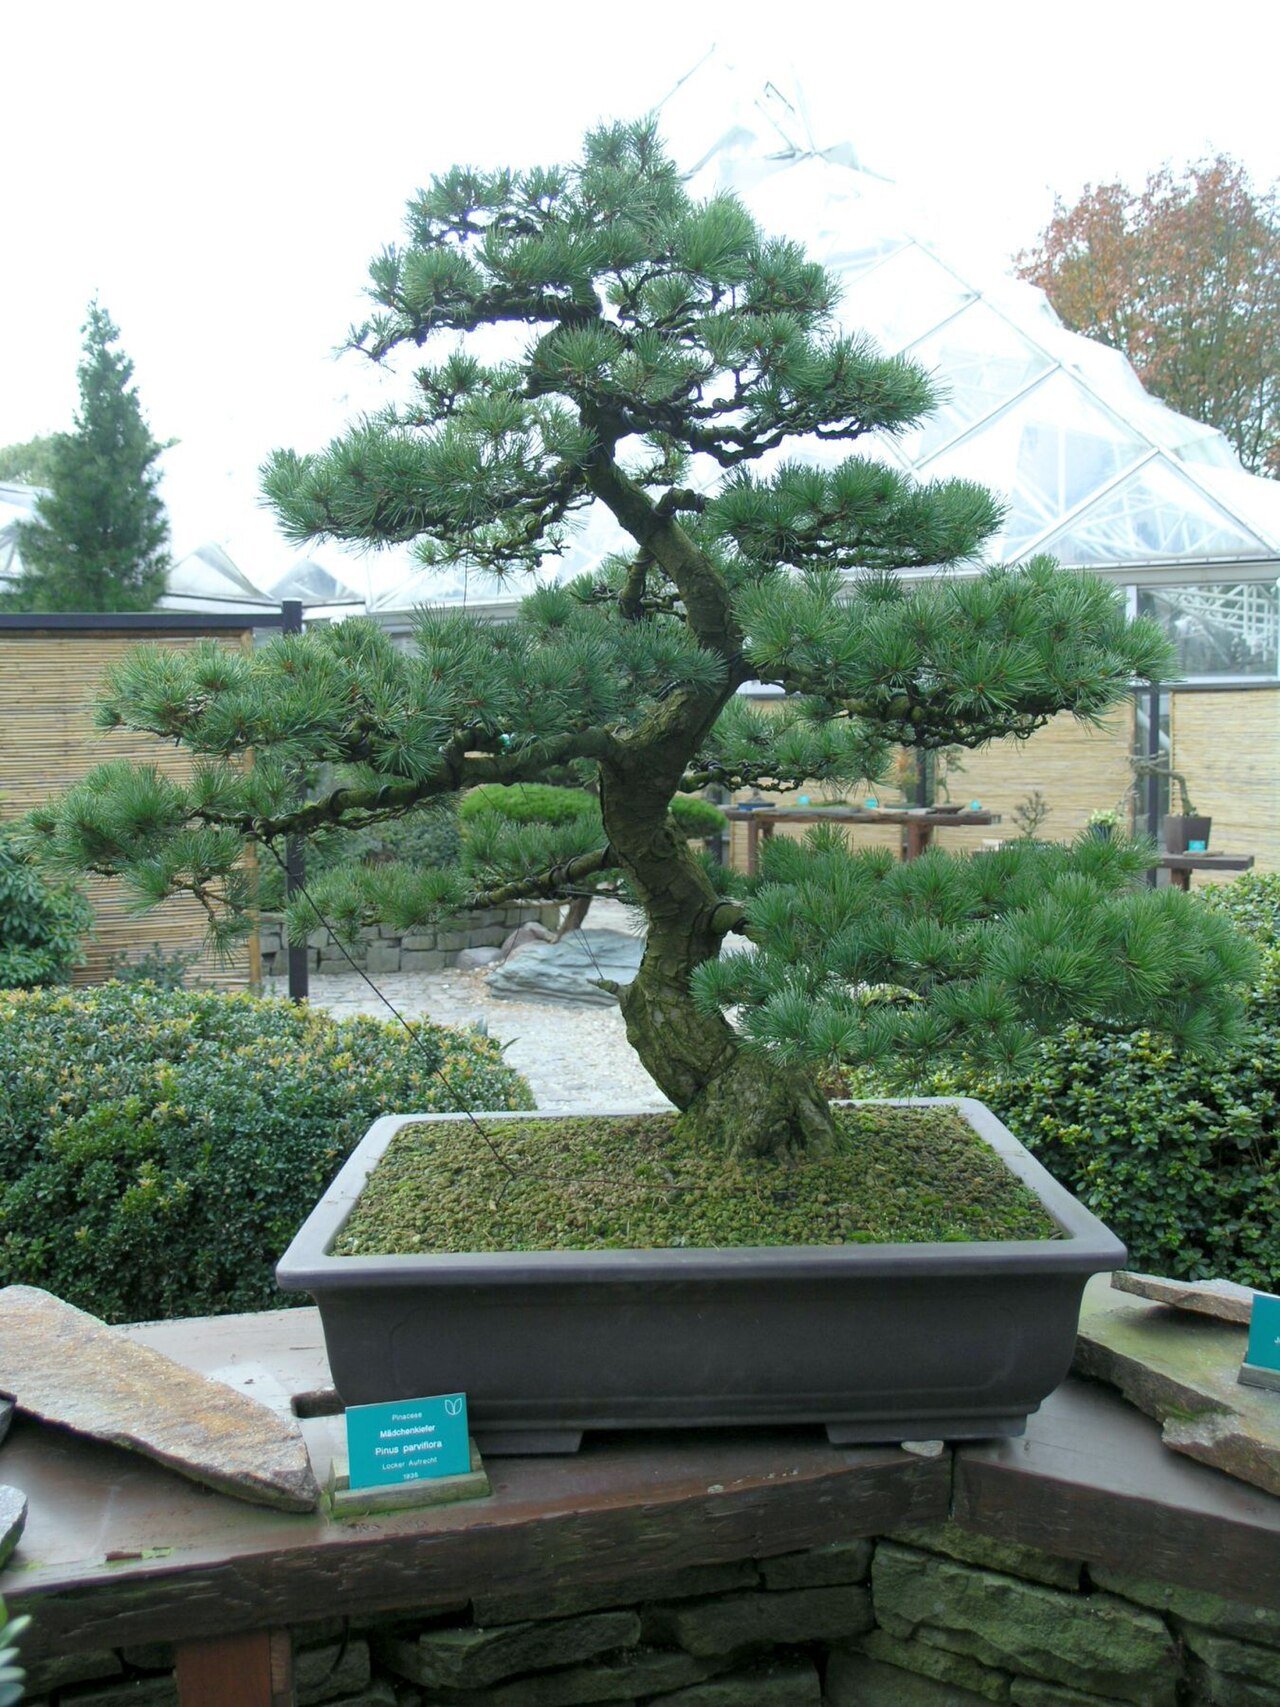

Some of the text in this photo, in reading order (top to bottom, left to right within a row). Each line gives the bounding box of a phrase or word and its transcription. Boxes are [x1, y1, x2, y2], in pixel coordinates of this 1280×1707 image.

[380, 1425, 435, 1438] Mädchenkiefer
[375, 1441, 442, 1456] Pinus parviflora
[382, 1457, 438, 1470] Locker Aufrecht
